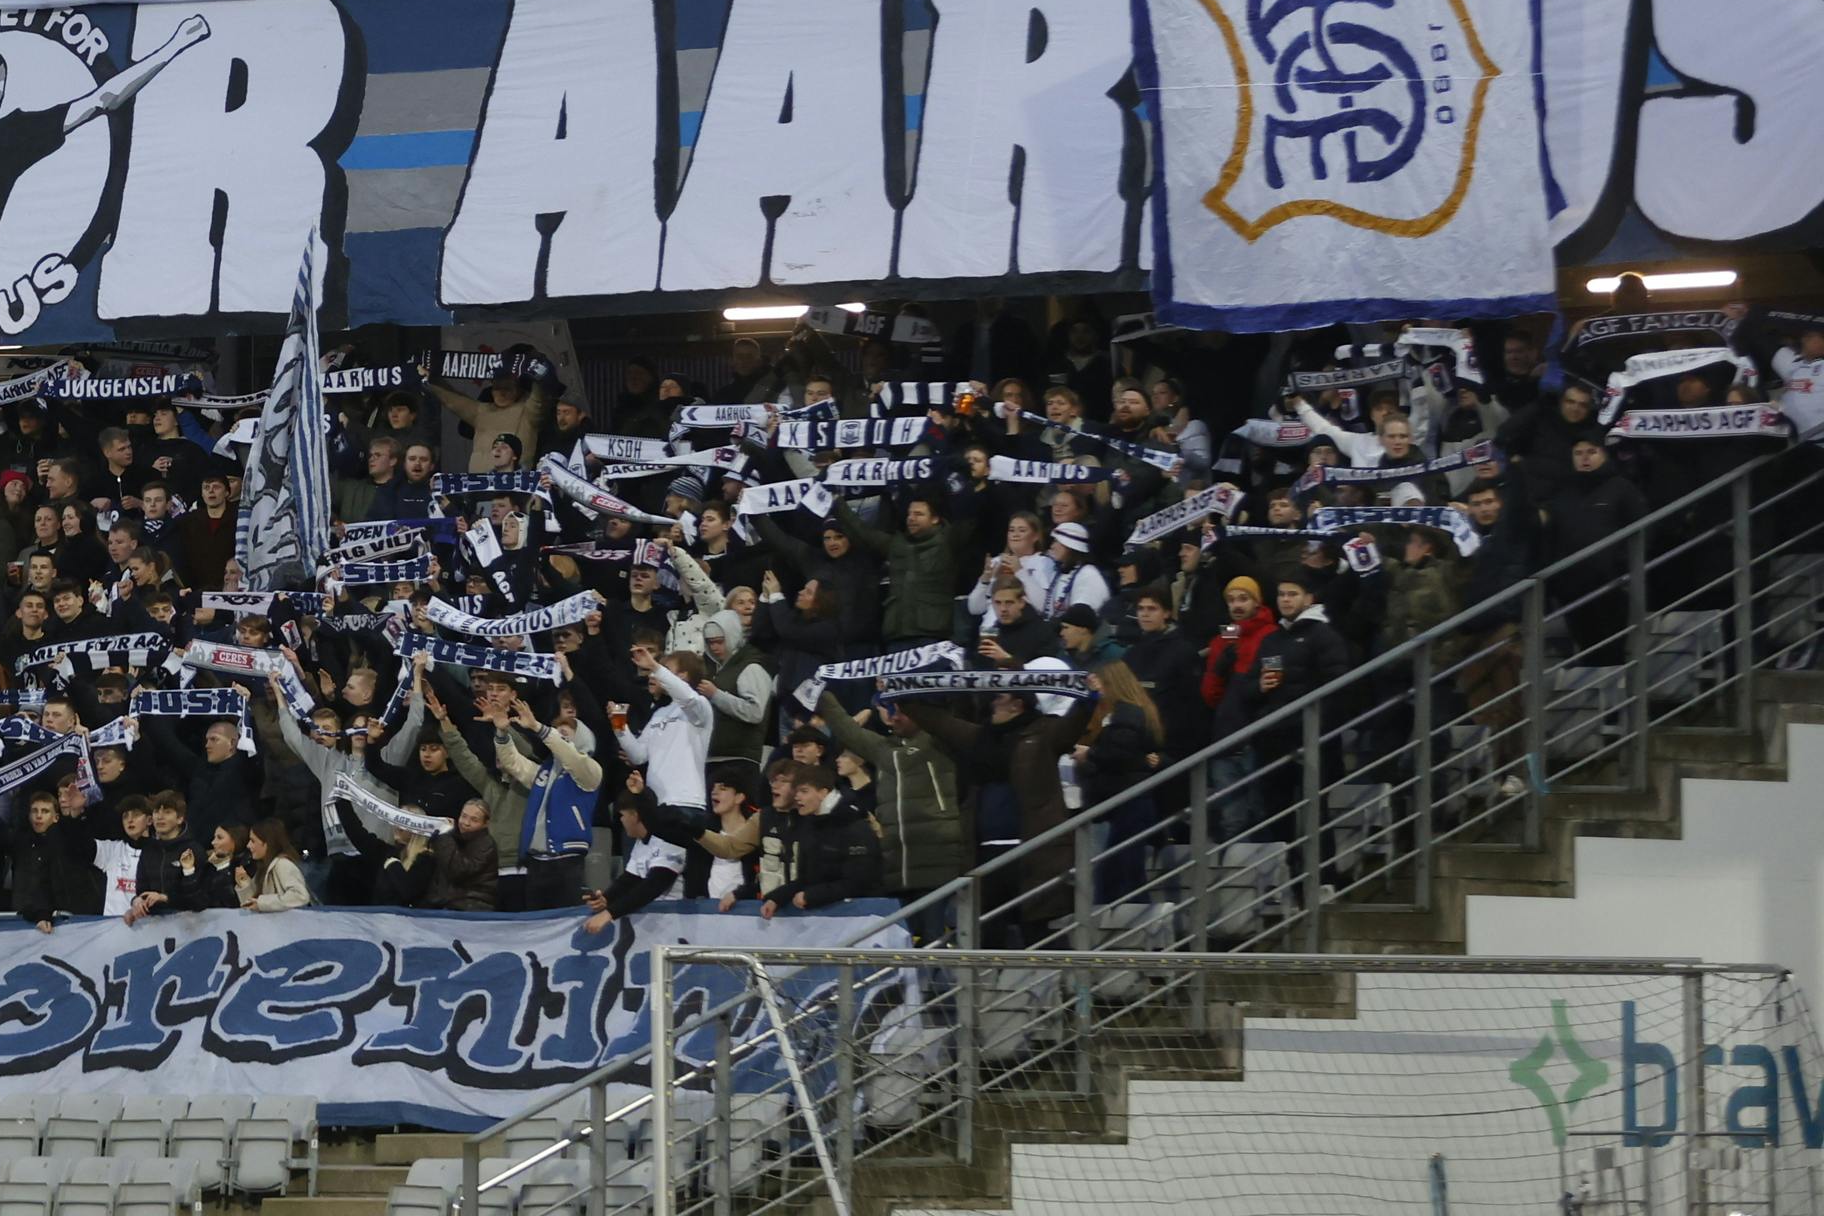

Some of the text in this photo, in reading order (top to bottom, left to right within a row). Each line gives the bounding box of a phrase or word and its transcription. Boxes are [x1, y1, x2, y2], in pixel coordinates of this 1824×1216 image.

[42, 7, 110, 67] FOR
[854, 312, 885, 334] AGF
[1579, 316, 1626, 341] AGF
[442, 352, 499, 377] AARHUS
[58, 376, 176, 399] JØRGENSEN
[322, 365, 403, 389] AARHUS
[716, 407, 752, 422] AARHUS
[1634, 407, 1756, 433] AARHUS AGF
[608, 438, 642, 458] KSDH
[841, 457, 932, 481] AARHUS
[1013, 457, 1089, 480] AARHUS
[476, 605, 552, 635] AARHUS
[217, 651, 249, 664] CERES
[841, 646, 922, 677] AARHUS
